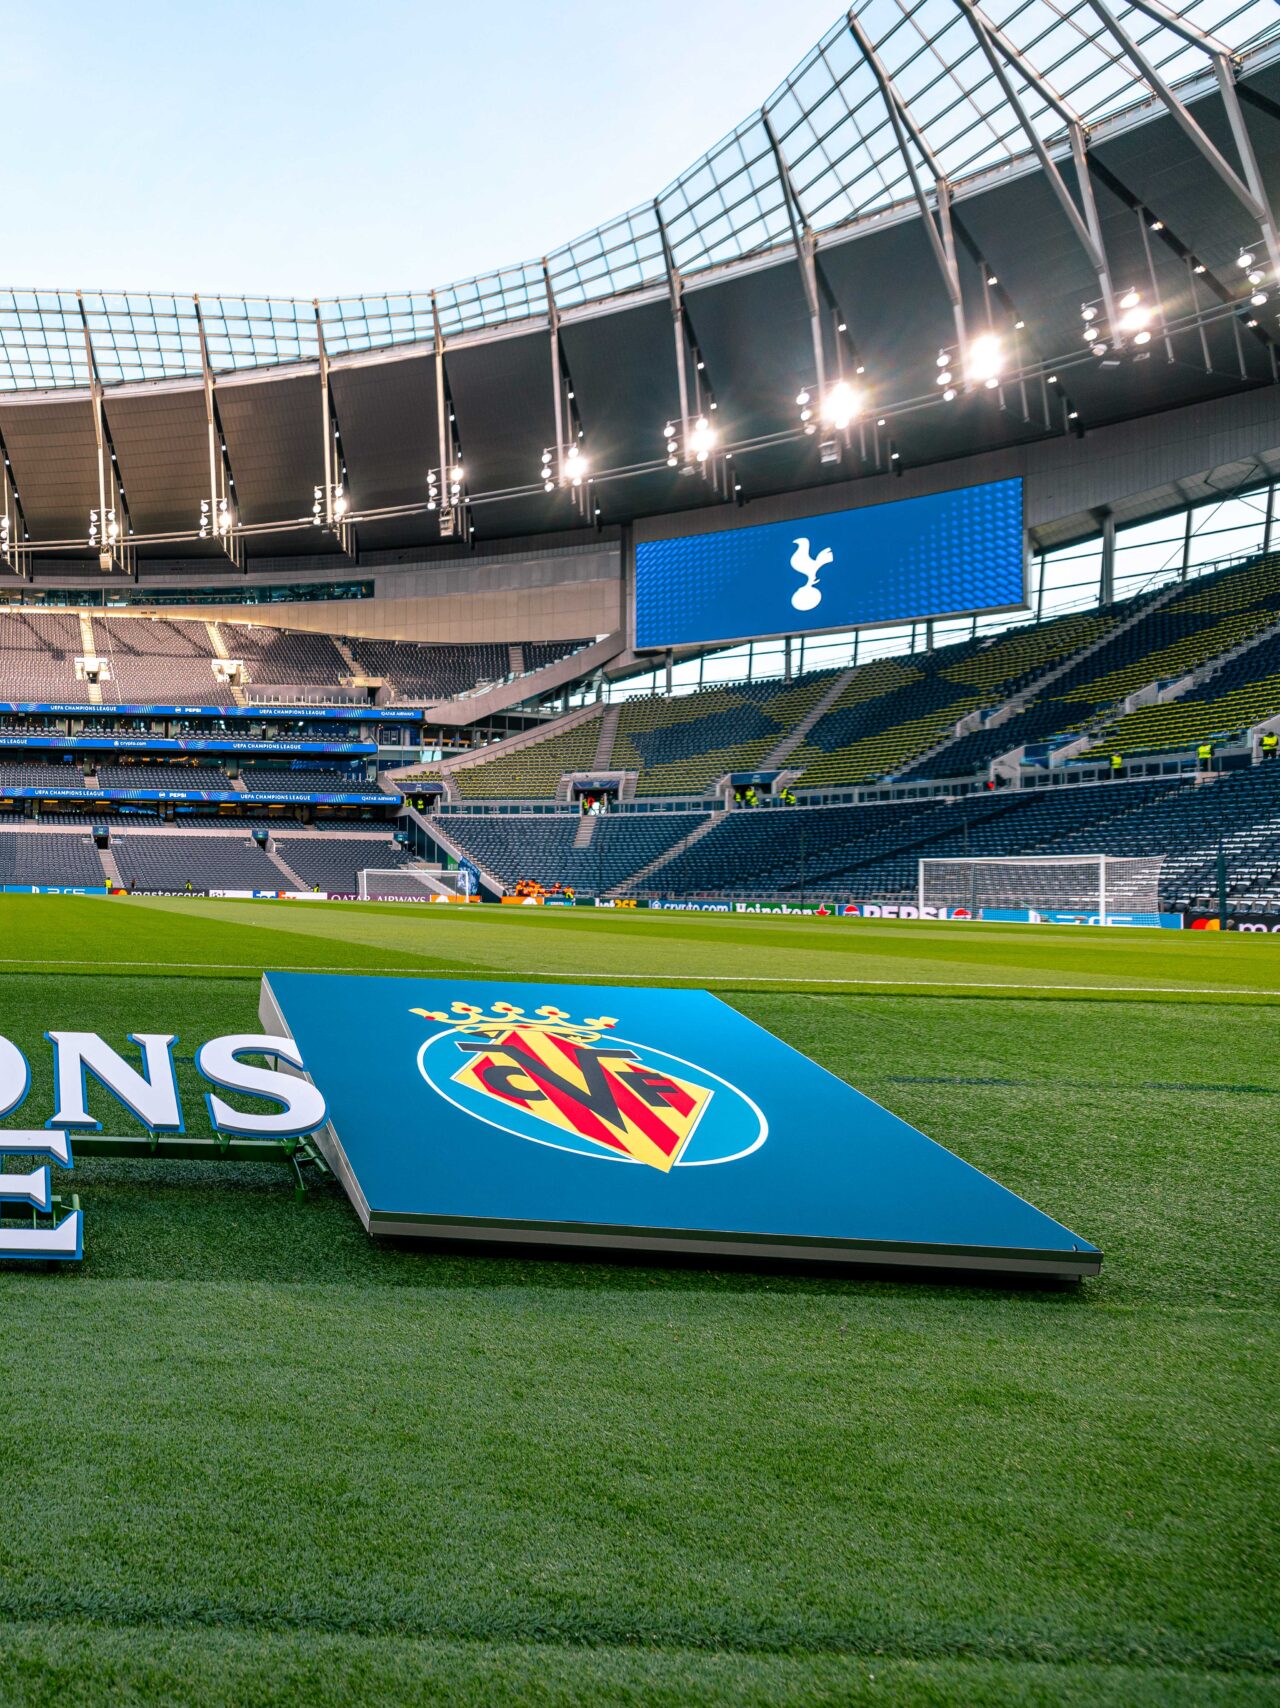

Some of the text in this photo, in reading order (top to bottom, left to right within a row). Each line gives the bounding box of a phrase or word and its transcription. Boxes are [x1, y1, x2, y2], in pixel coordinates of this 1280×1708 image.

[664, 903, 728, 912] cryptocom
[735, 903, 812, 915] Heineken
[863, 905, 947, 920] PEPSI
